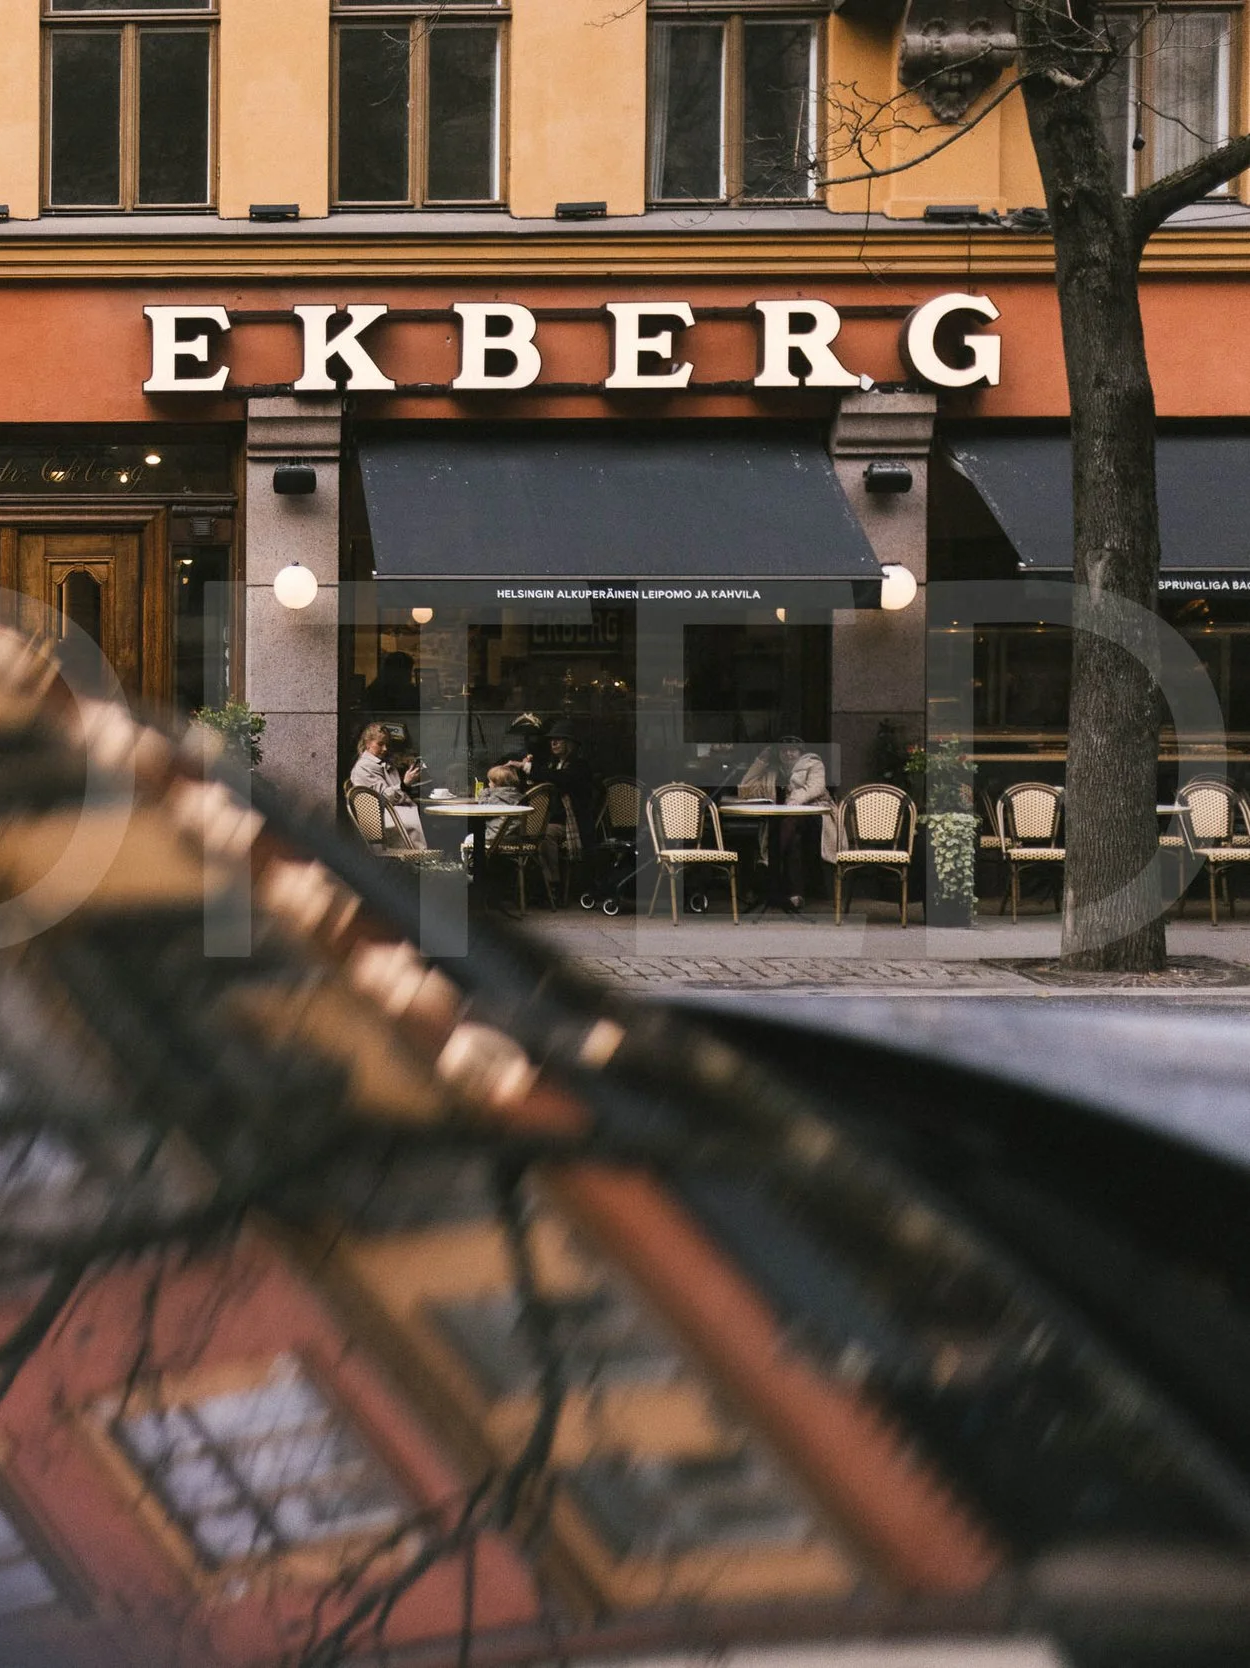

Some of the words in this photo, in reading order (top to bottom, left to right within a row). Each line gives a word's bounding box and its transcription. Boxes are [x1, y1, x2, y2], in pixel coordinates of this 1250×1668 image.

[142, 292, 1002, 392] EKBERG
[496, 589, 554, 599] HELSINGIN
[556, 587, 639, 600] ALKUPERÄINEN
[641, 589, 692, 600] LEIPOMO
[694, 589, 709, 600] JA
[711, 589, 761, 600] KAHVILA
